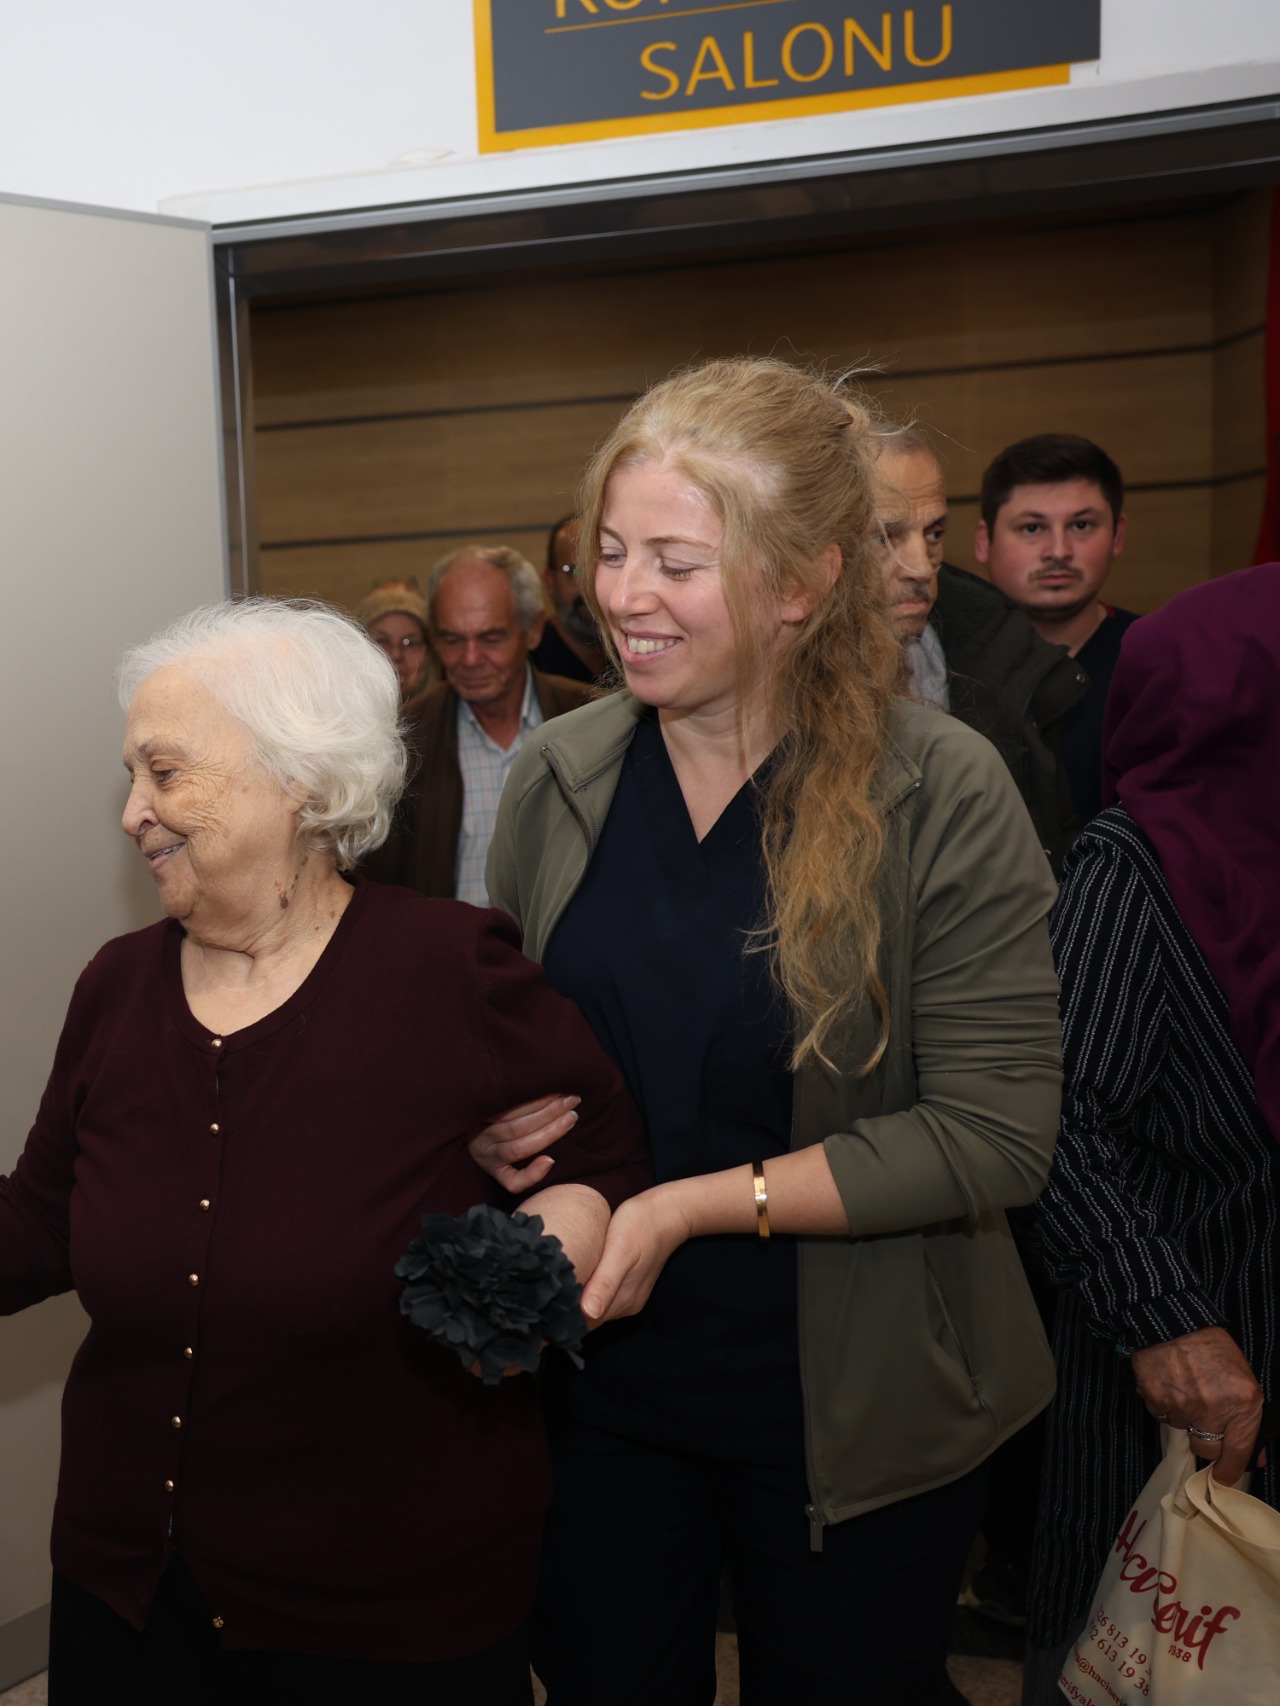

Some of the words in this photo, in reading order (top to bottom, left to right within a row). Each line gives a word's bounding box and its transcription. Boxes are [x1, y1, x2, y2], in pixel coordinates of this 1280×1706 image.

[639, 4, 953, 100] SALONU
[1097, 1639, 1118, 1662] 613
[1117, 1661, 1136, 1678] 19
[1134, 1677, 1150, 1697] 38
[1107, 1624, 1129, 1649] 813
[1128, 1648, 1147, 1665] 19
